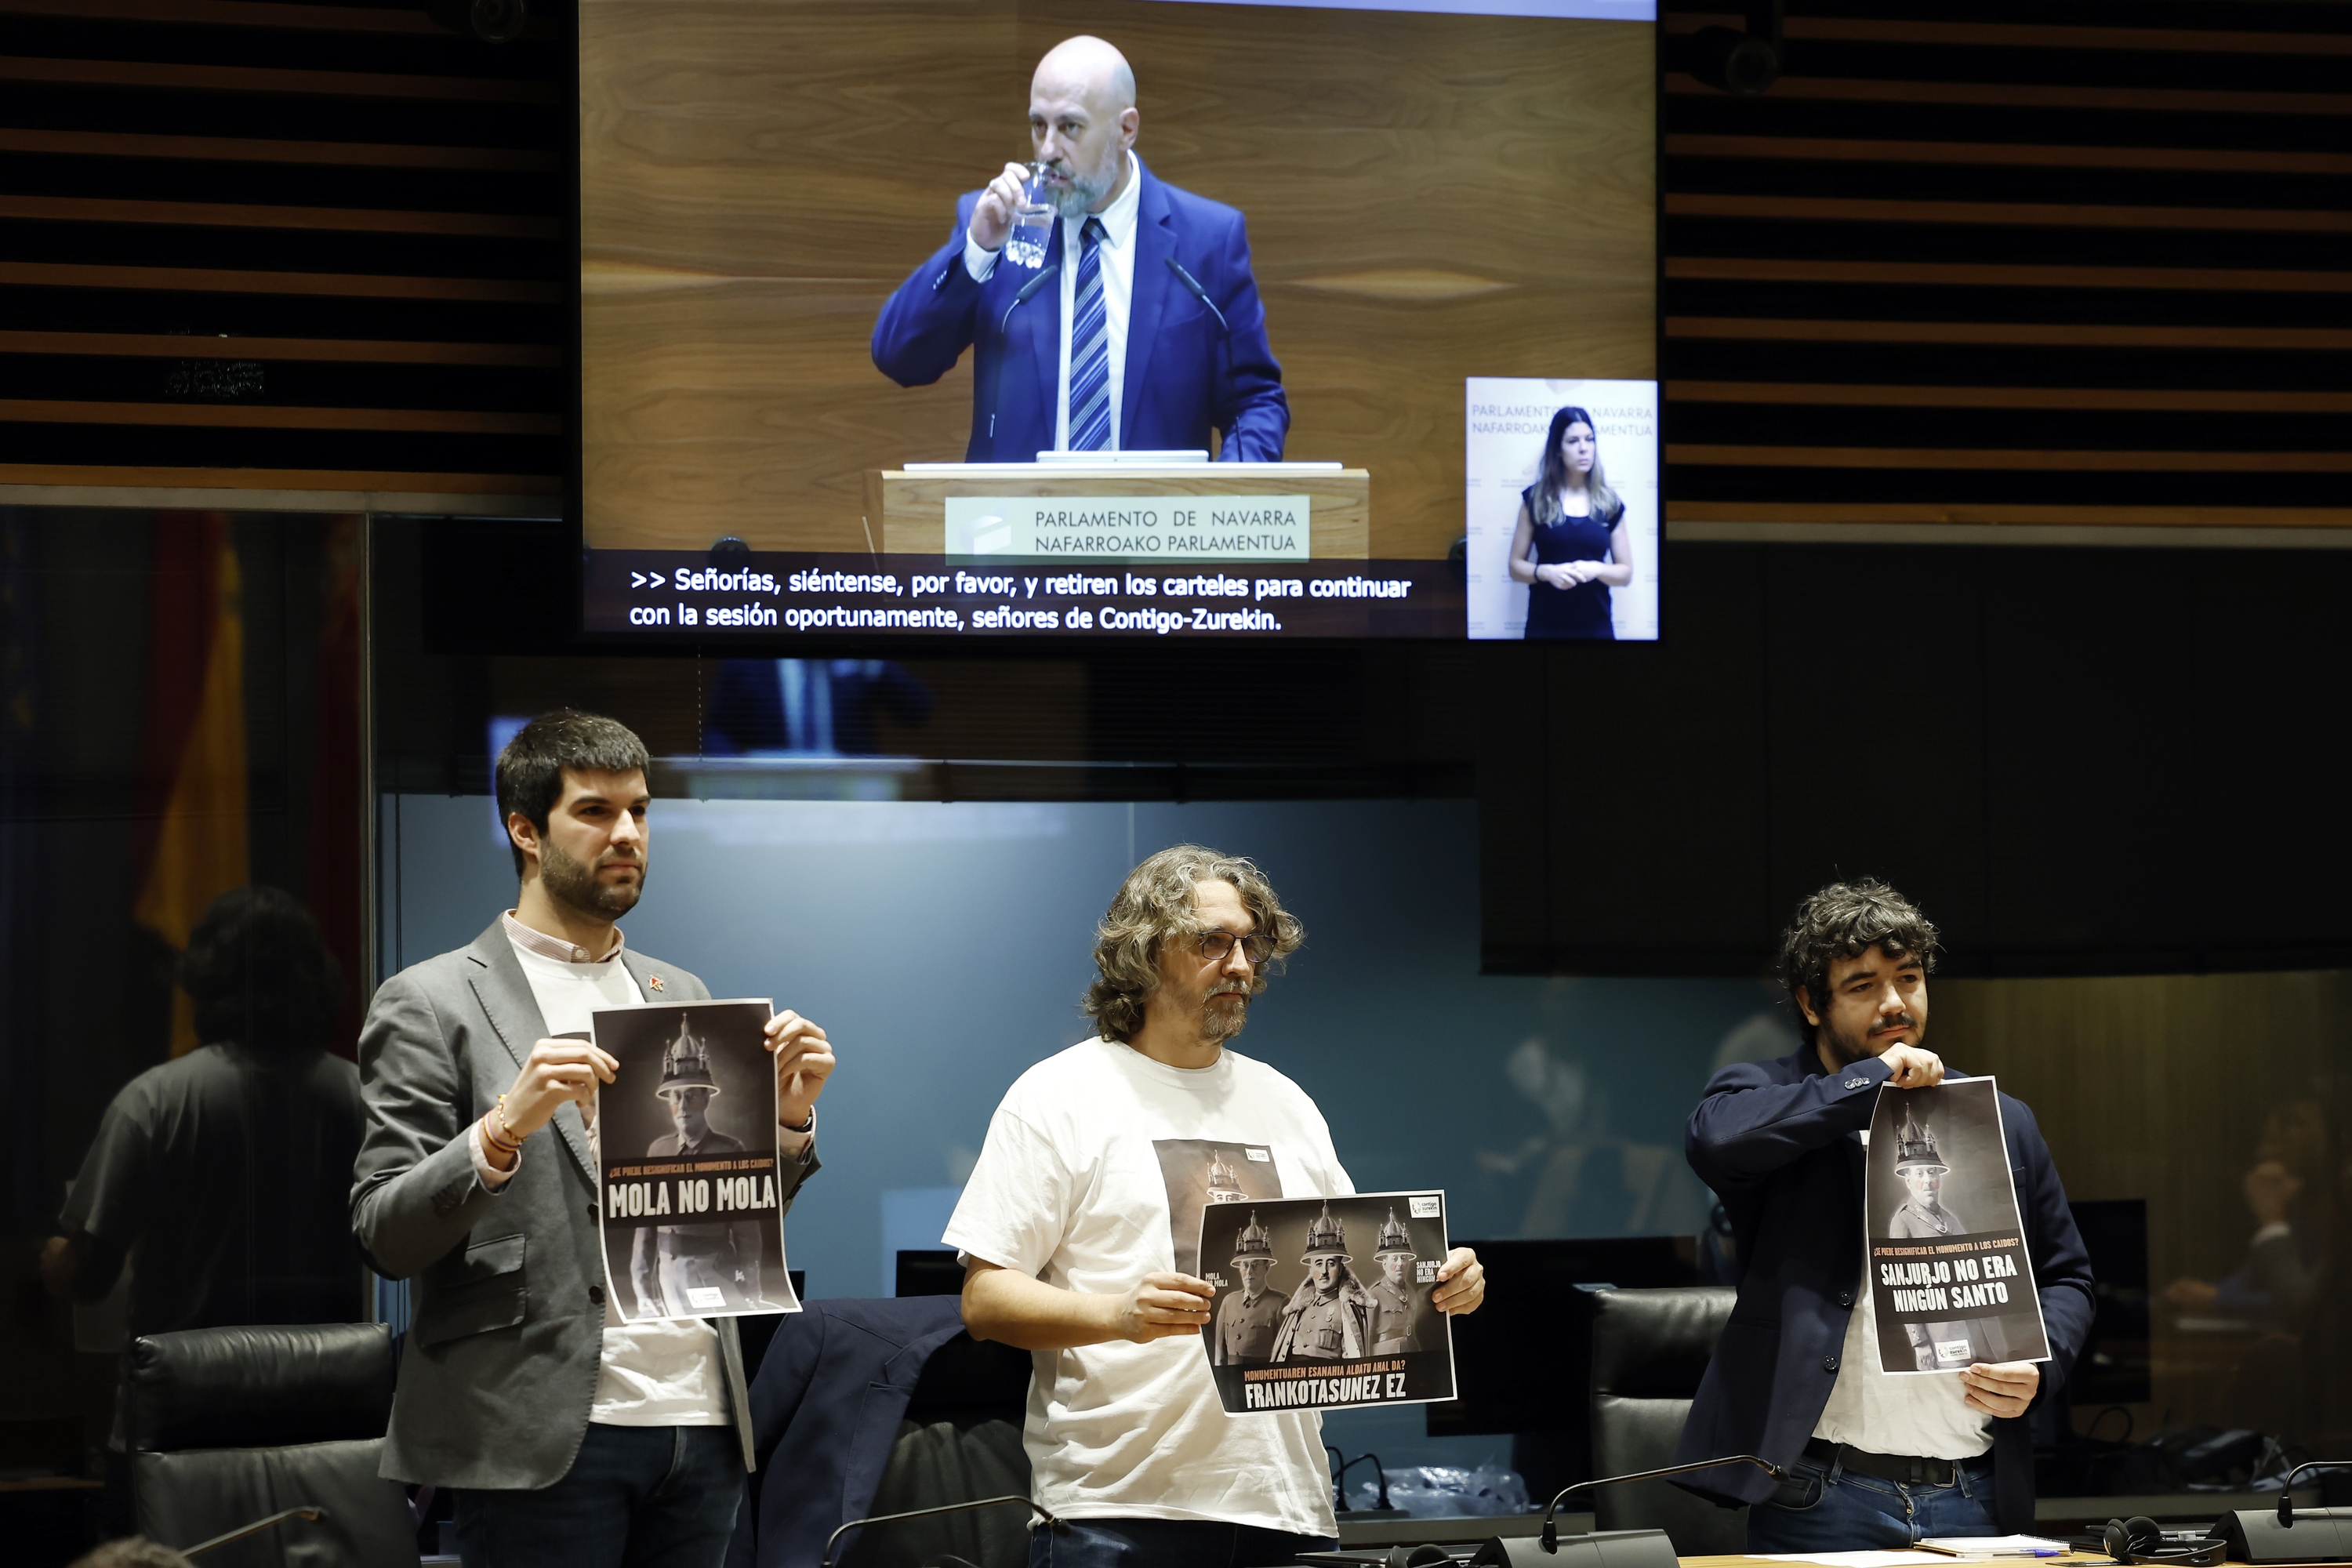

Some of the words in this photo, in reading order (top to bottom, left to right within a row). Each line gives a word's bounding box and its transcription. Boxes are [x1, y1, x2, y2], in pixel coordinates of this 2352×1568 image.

[1592, 407, 1653, 419] NAVARRA
[1472, 423, 1549, 434] NAFARROAK
[1595, 424, 1653, 436] AMENTUA
[1036, 511, 1157, 527] PARLAMENTO
[1174, 510, 1196, 526] DE
[1212, 510, 1296, 526] NAVARRA
[1036, 536, 1160, 552] NAFARROAKO
[1168, 535, 1296, 551] PARLAMENTUA
[674, 567, 782, 596] Señorías,
[789, 568, 904, 597] siéntense,
[912, 573, 950, 597] por
[955, 571, 1017, 598] favor,
[1024, 576, 1038, 598] y
[1045, 573, 1118, 596] retiren
[1125, 573, 1157, 596] los
[1163, 574, 1249, 597] carteles
[1255, 578, 1303, 601] para
[1309, 576, 1412, 598] continuar
[630, 607, 670, 625] con
[678, 602, 699, 625] la
[706, 601, 778, 626] sesión
[785, 604, 966, 632] oportunamente,
[972, 604, 1058, 629] señores
[1065, 606, 1093, 629] de
[1099, 607, 1282, 634] Contigo-Zurekin.
[686, 1163, 694, 1173] EL
[732, 1160, 738, 1170] A
[738, 1159, 750, 1169] LOS
[608, 1181, 671, 1218] MOLA
[678, 1179, 710, 1214] NO
[717, 1175, 776, 1211] MOLA
[1881, 1247, 1894, 1256] PUEDE
[1895, 1247, 1928, 1256] RESIGNIFICAR
[1928, 1246, 1935, 1254] EL
[1936, 1243, 1973, 1254] MONUMENTO
[1980, 1241, 1992, 1250] LOS
[1992, 1237, 2019, 1248] CAIDOS?
[1881, 1261, 1951, 1286] SANJURJO
[1953, 1258, 1980, 1282] NO
[1982, 1254, 2018, 1279] ERA
[1893, 1283, 1948, 1312] NINGÚN
[1951, 1282, 2009, 1308] SANTO
[1244, 1367, 1306, 1381] MONUMENTUAREN
[1308, 1366, 1345, 1377] ESANAHIA
[1346, 1363, 1372, 1375] ALDATU
[1373, 1361, 1390, 1372] AHAL
[1392, 1359, 1406, 1370] DA?
[1245, 1374, 1380, 1409] FRANKOTASUNEZ
[1386, 1373, 1406, 1398] EZ
